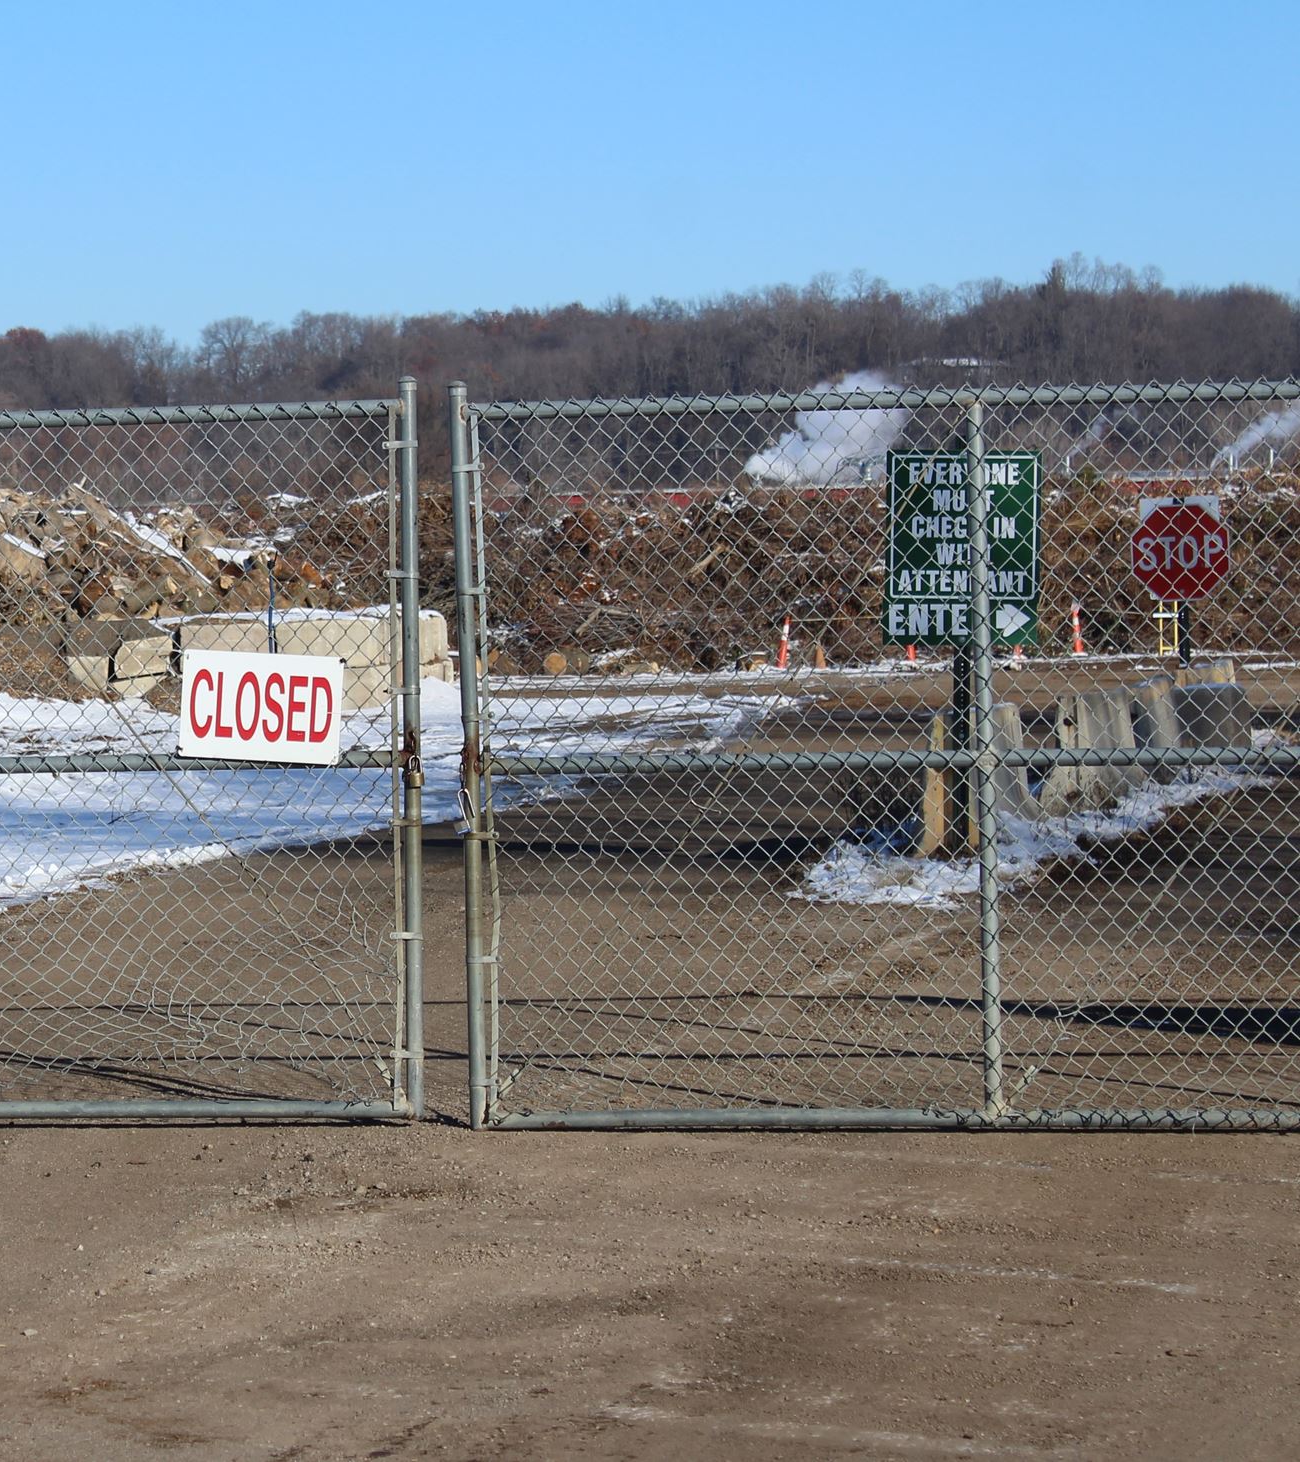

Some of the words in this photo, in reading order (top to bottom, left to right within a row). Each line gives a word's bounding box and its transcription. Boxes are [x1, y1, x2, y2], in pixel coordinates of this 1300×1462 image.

[909, 462, 1019, 485] EVERNE
[932, 489, 995, 512] MUT
[912, 516, 968, 539] CHEC
[993, 516, 1015, 539] IN
[935, 543, 991, 566] WIT
[1138, 534, 1223, 571] STOP
[898, 570, 1027, 593] ATTENANT
[888, 604, 969, 636] ENTE
[190, 669, 333, 743] CLOSED
